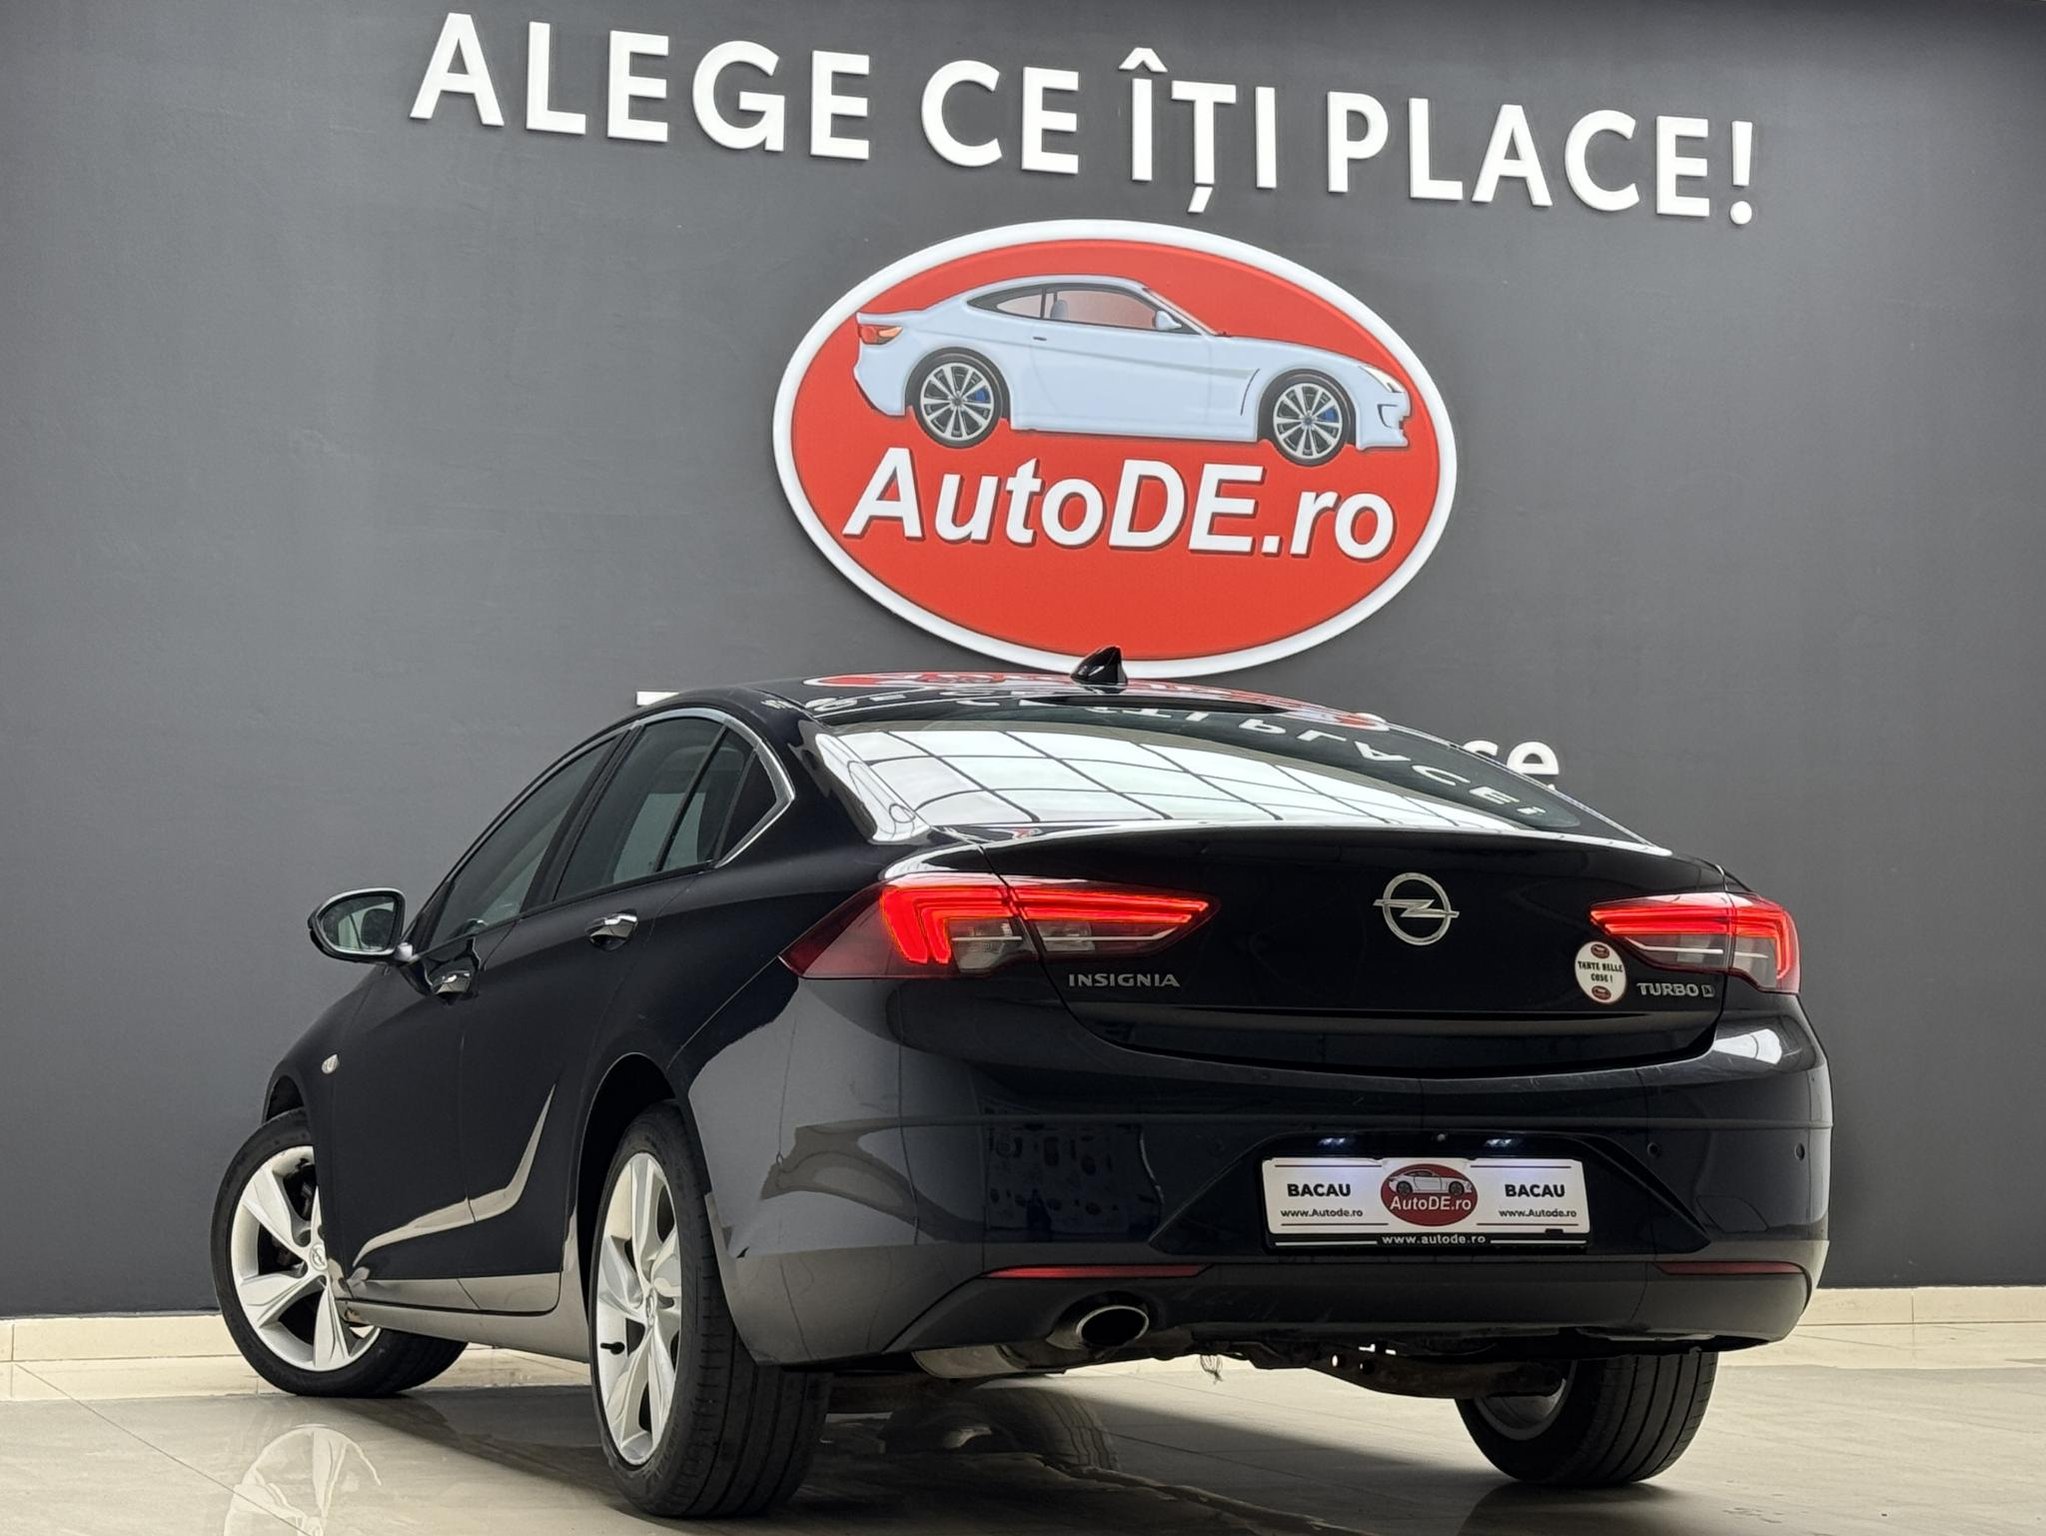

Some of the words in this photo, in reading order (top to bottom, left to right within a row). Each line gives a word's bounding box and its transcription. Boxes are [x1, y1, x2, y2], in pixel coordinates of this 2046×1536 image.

[410, 12, 869, 160] ALEGE
[920, 60, 1079, 175] CE
[1118, 47, 1277, 214] ÎȚI
[1327, 91, 1754, 226] PLACE!
[842, 447, 1397, 561] AutoDE.ro
[1068, 973, 1181, 988] INSIGNIA
[1637, 982, 1699, 997] TURBO
[1287, 1183, 1351, 1198] BACAU
[1505, 1184, 1566, 1198] BACAU
[1389, 1195, 1472, 1213] AutoDE.ro
[1280, 1207, 1364, 1219] www.Autode.ro
[1499, 1208, 1577, 1219] www.Autode.ro
[1382, 1234, 1487, 1246] www.autode.ro
